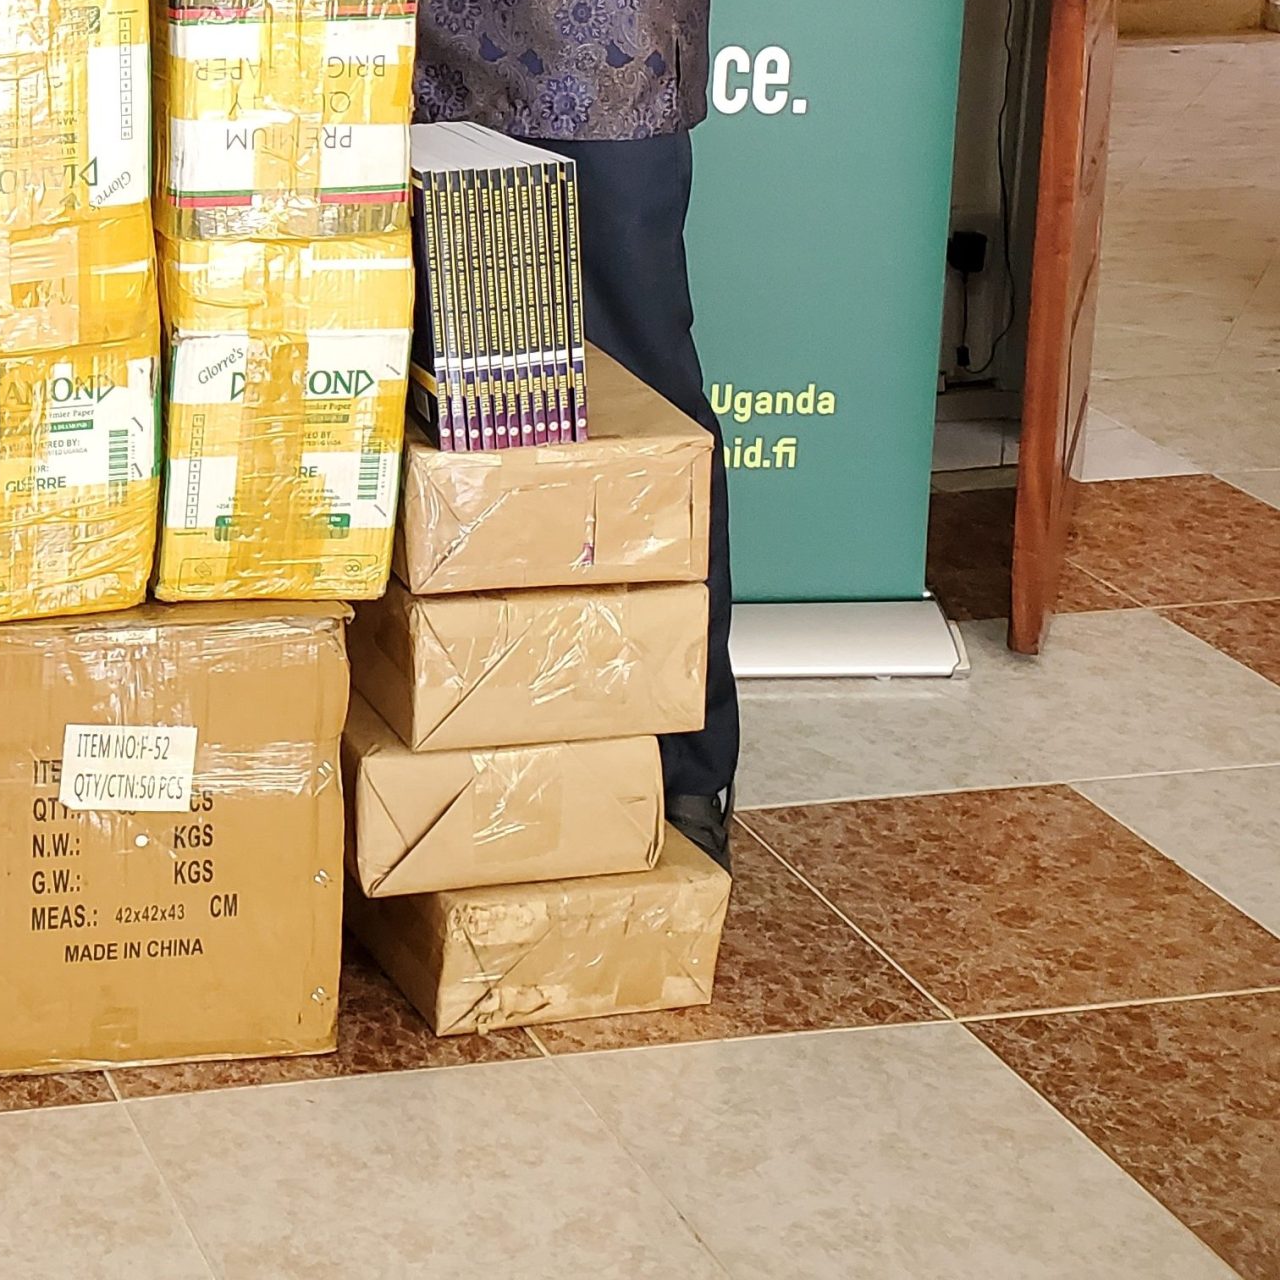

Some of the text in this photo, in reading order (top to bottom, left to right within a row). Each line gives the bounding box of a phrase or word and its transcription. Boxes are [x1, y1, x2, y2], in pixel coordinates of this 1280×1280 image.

[712, 45, 808, 115] ce.
[710, 383, 836, 423] Uganda
[76, 733, 171, 761] ITEM NO:F-52
[73, 773, 184, 804] QTY/CTN:50 PCS
[173, 823, 214, 849] KGS
[174, 860, 214, 885] KGS
[32, 893, 239, 931] MEAS.: 42x42x43 CM
[64, 938, 204, 963] MADE IN CHINA
